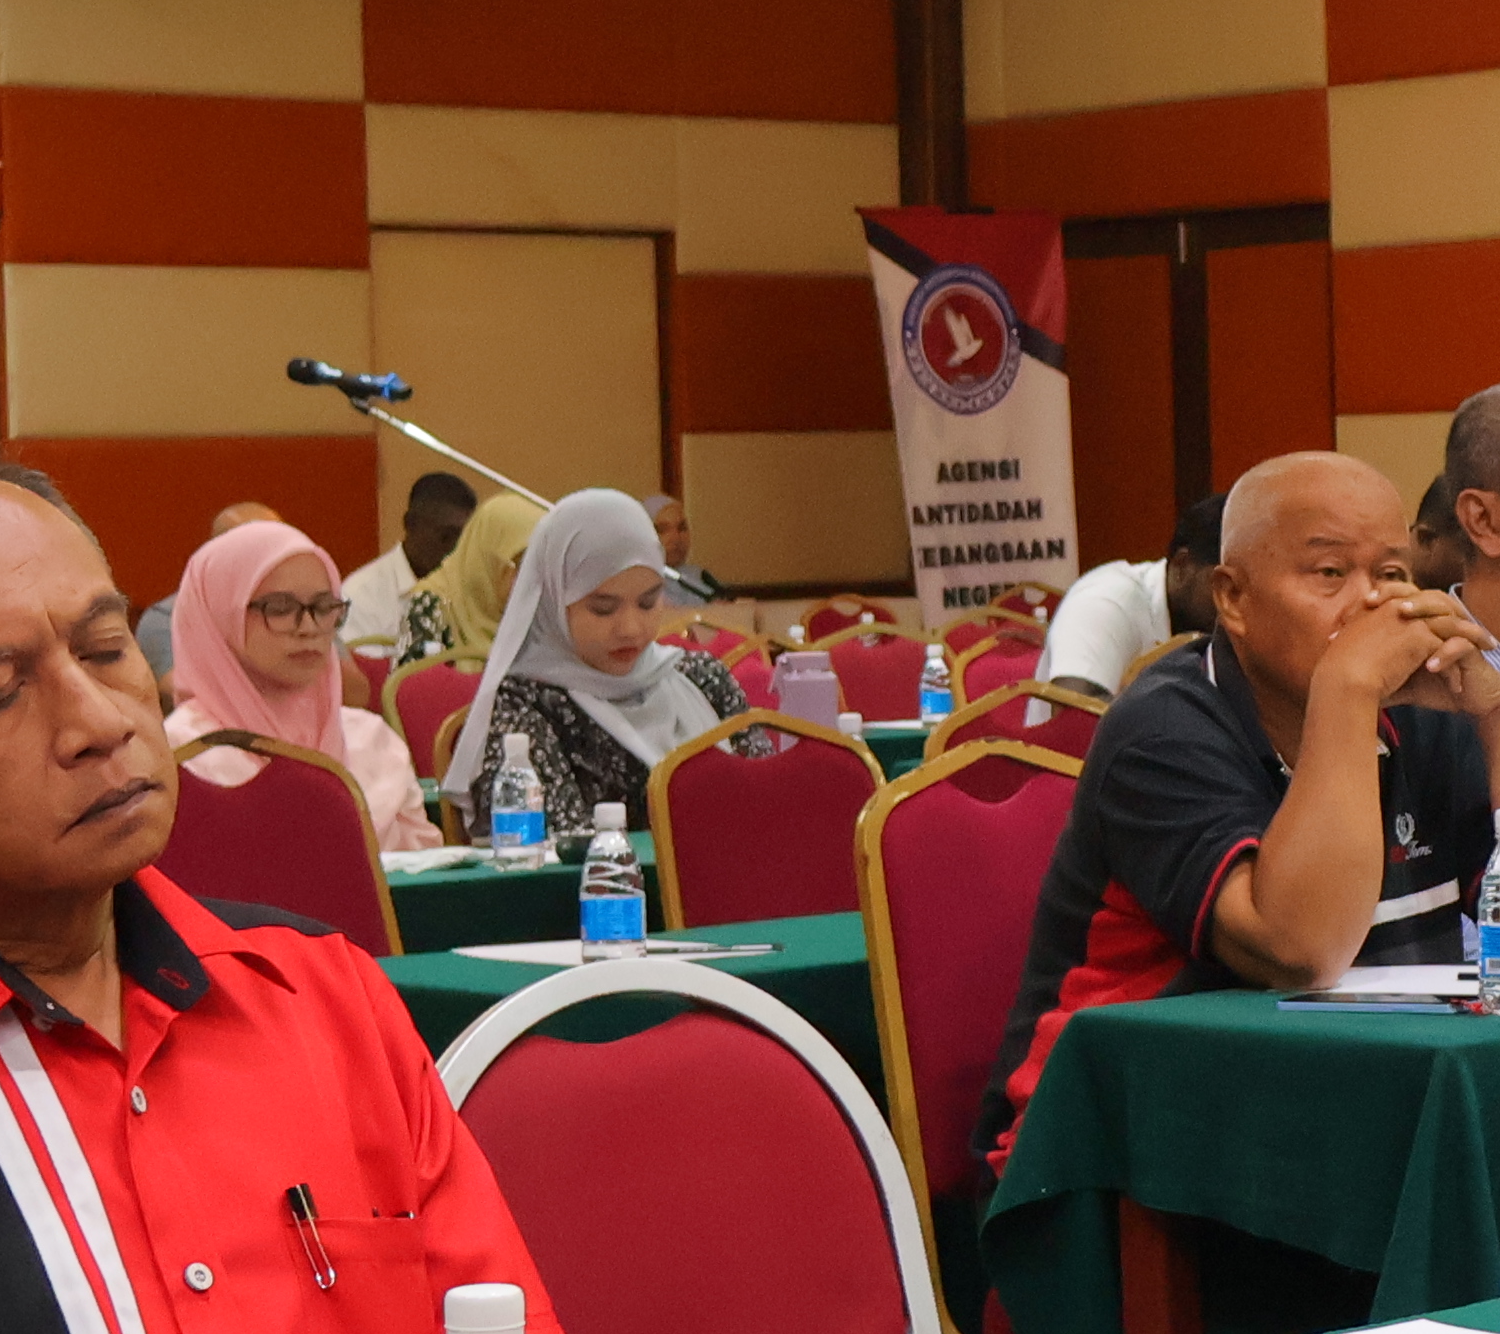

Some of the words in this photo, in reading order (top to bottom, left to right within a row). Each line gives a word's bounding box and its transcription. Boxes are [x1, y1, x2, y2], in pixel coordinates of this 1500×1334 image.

[937, 459, 1020, 483] AGENSI
[912, 498, 1042, 525] ANTIDADAH
[919, 539, 1066, 568] EBANGSAAN
